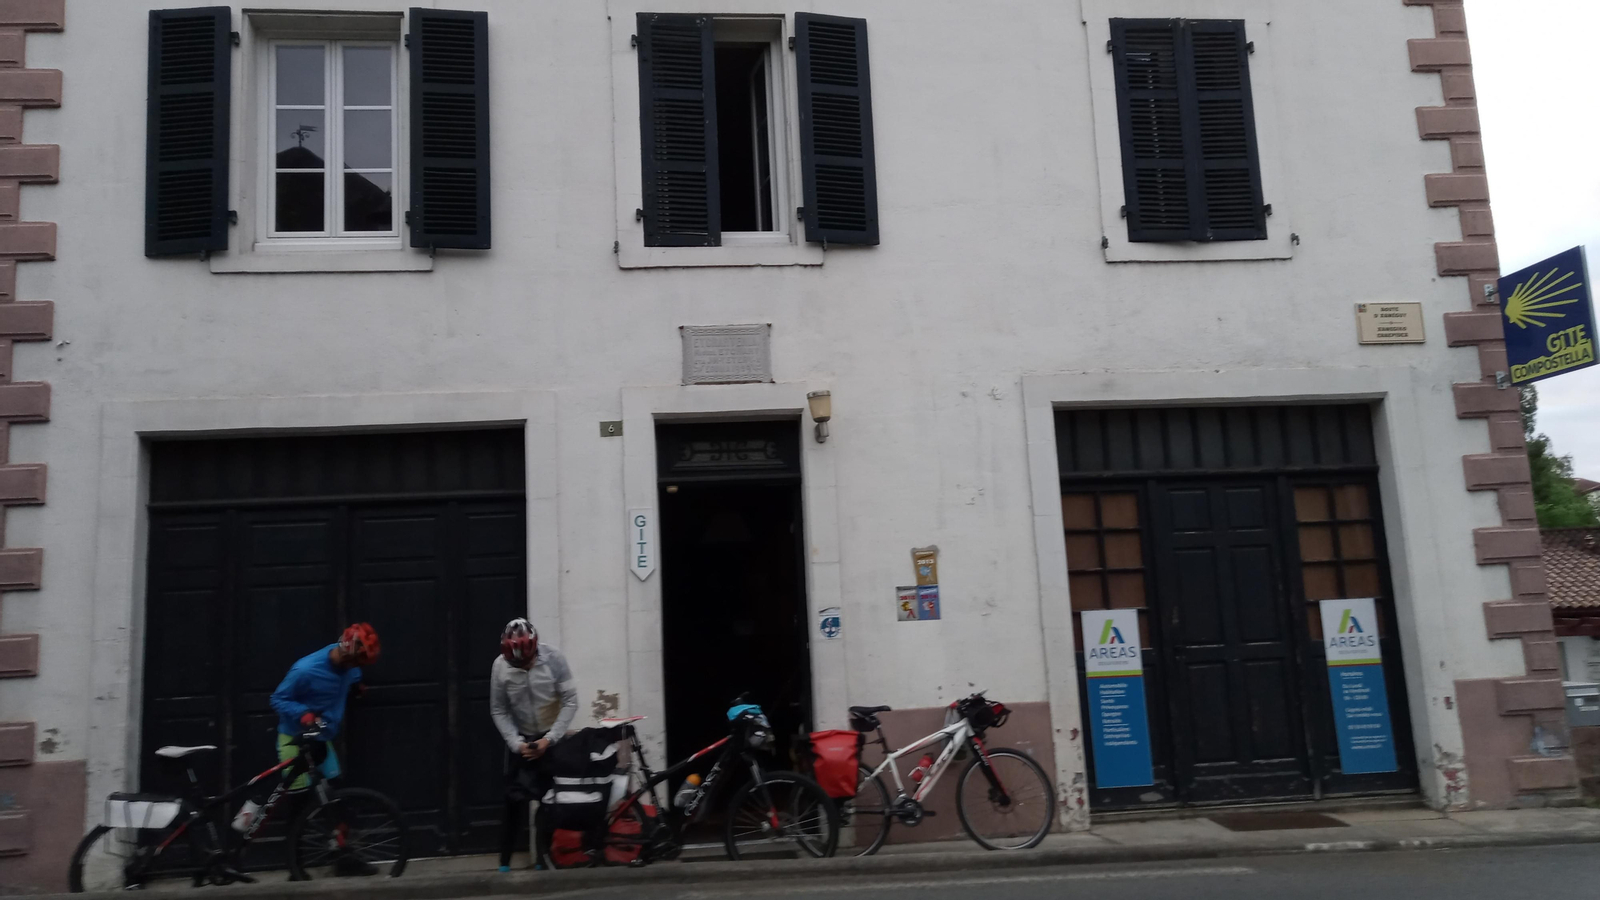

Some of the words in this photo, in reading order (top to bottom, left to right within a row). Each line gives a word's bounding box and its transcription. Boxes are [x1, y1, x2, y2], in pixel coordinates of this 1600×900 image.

[1513, 347, 1591, 379] COMPOSTELLA
[607, 424, 615, 433] 6
[634, 515, 648, 568] GITE
[1329, 635, 1376, 648] AREAS
[1088, 646, 1138, 659] AREAS
